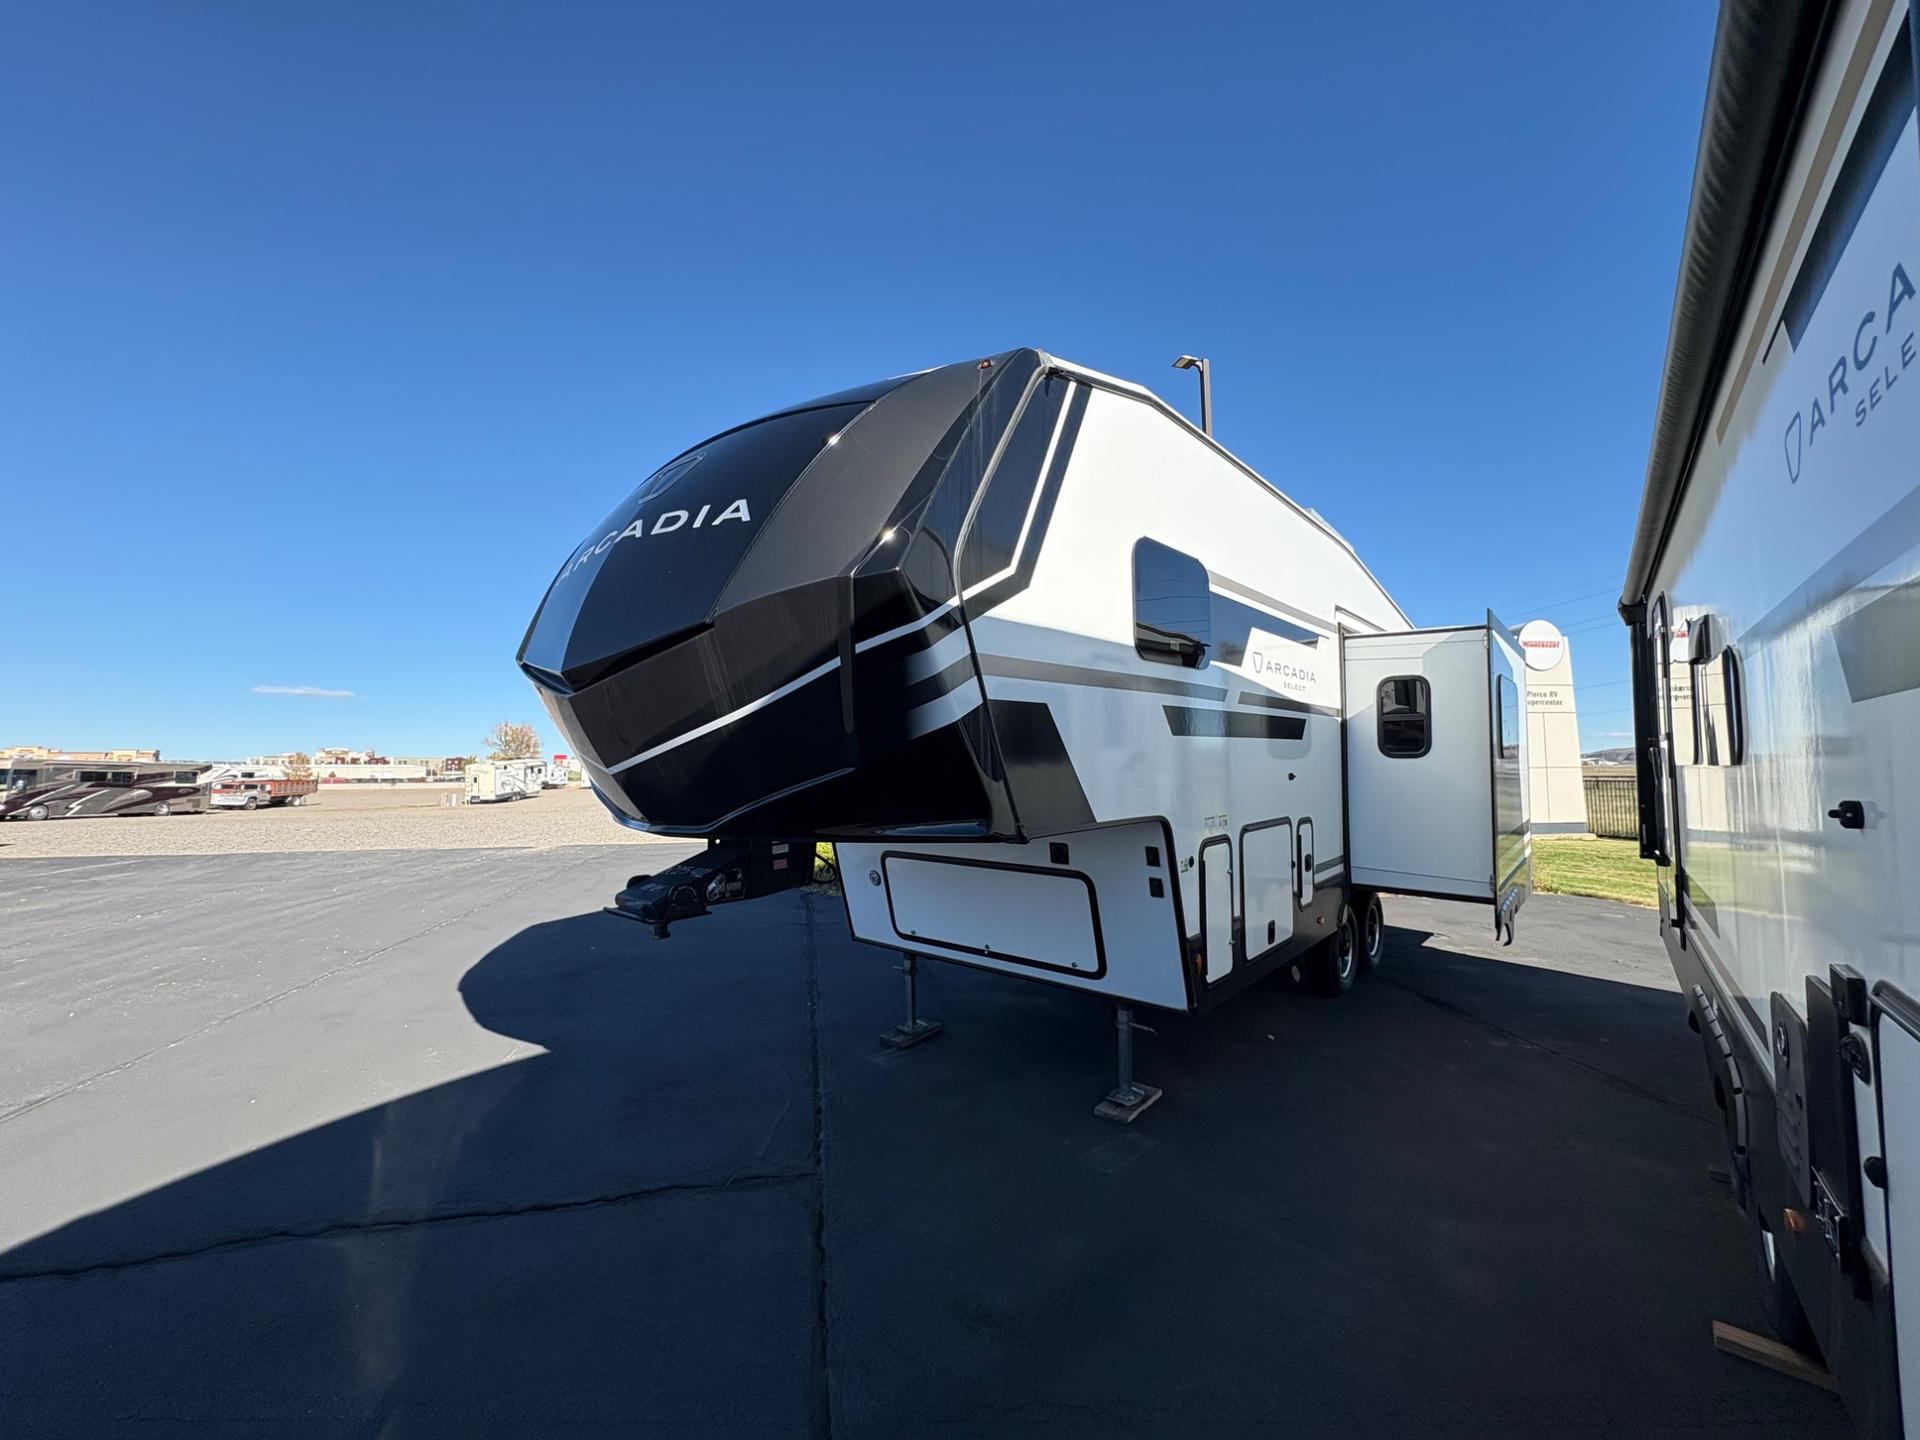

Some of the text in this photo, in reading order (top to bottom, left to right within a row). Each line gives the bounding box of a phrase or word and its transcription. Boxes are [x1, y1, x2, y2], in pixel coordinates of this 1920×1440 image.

[1855, 331, 1917, 428] SELE
[555, 499, 752, 586] ARCADIA
[1266, 660, 1317, 684] ARCADIA
[1283, 681, 1306, 692] SELECT
[1549, 690, 1558, 698] RV
